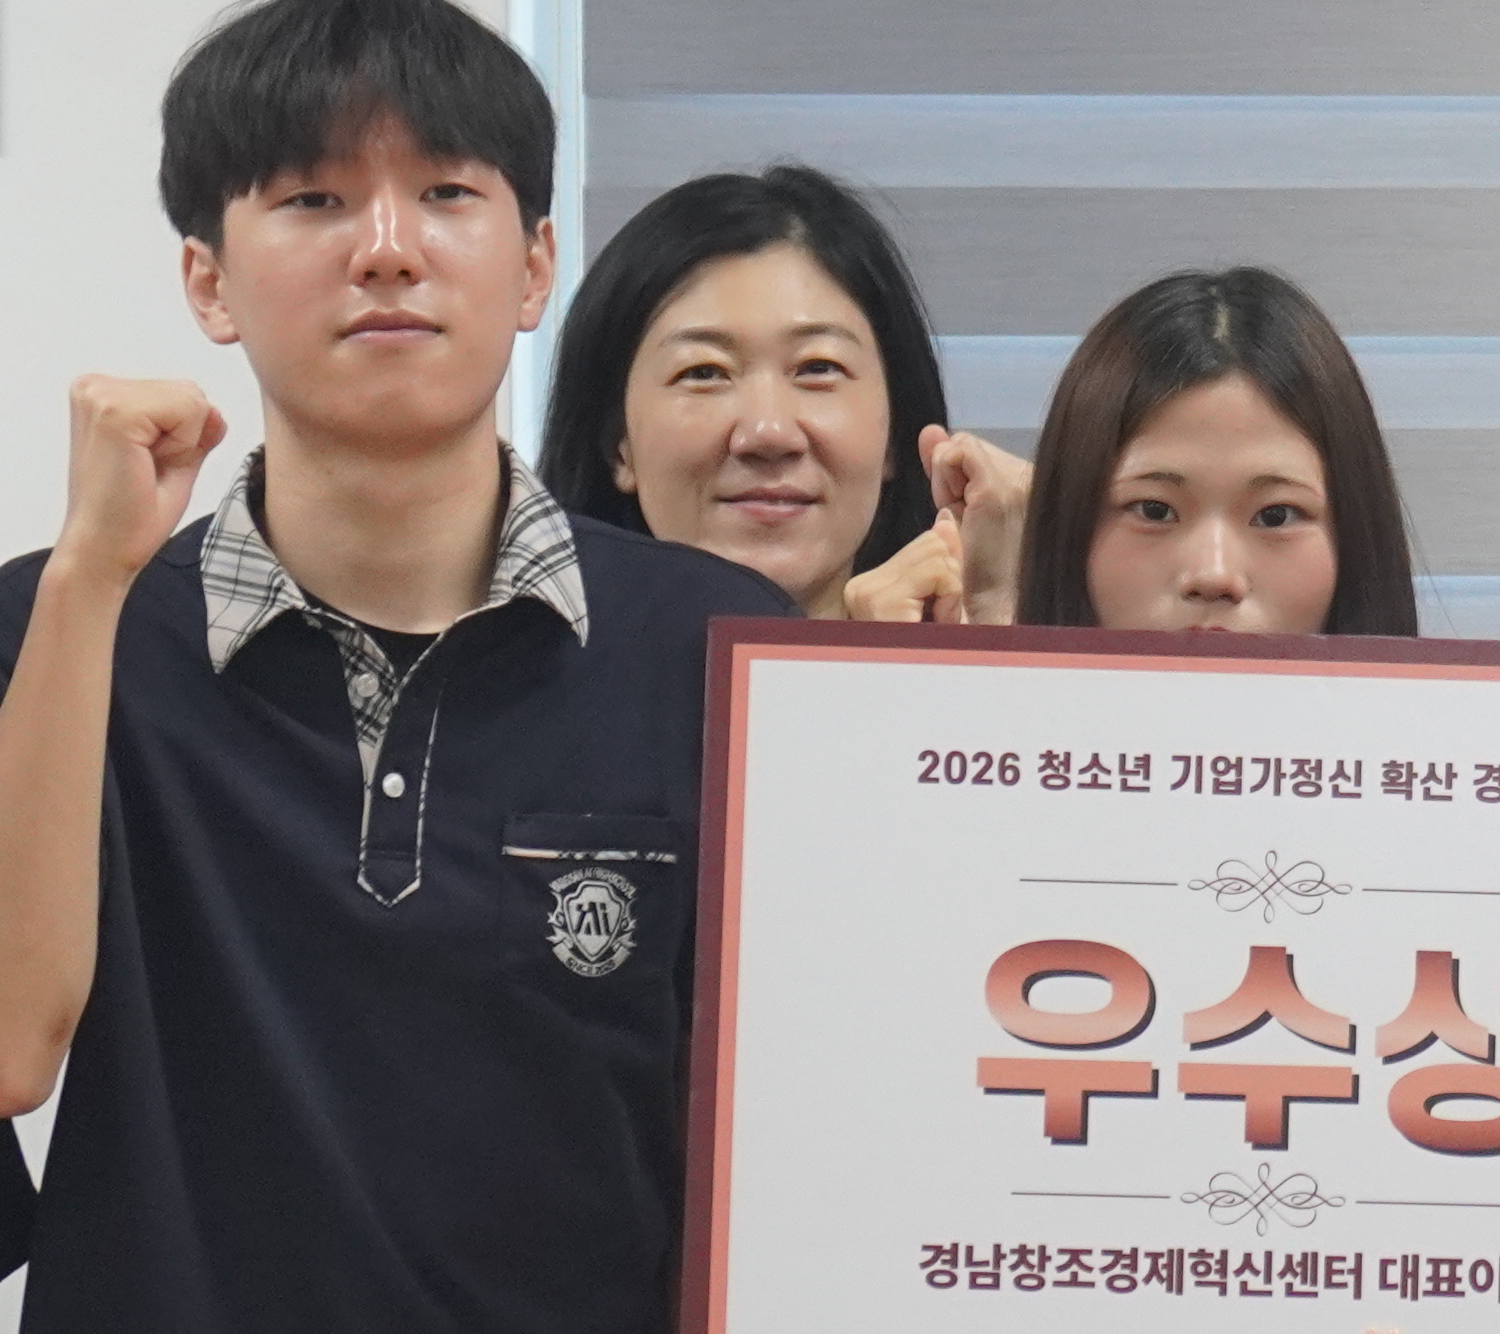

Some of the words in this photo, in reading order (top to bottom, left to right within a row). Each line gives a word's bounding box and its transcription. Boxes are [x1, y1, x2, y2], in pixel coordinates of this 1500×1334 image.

[917, 750, 1021, 788] 2026
[1037, 750, 1153, 795] 청소년
[1169, 754, 1365, 801] 기업가정신
[1379, 759, 1458, 805] 확산
[918, 1243, 1365, 1301] 경남창조경제혁신센터
